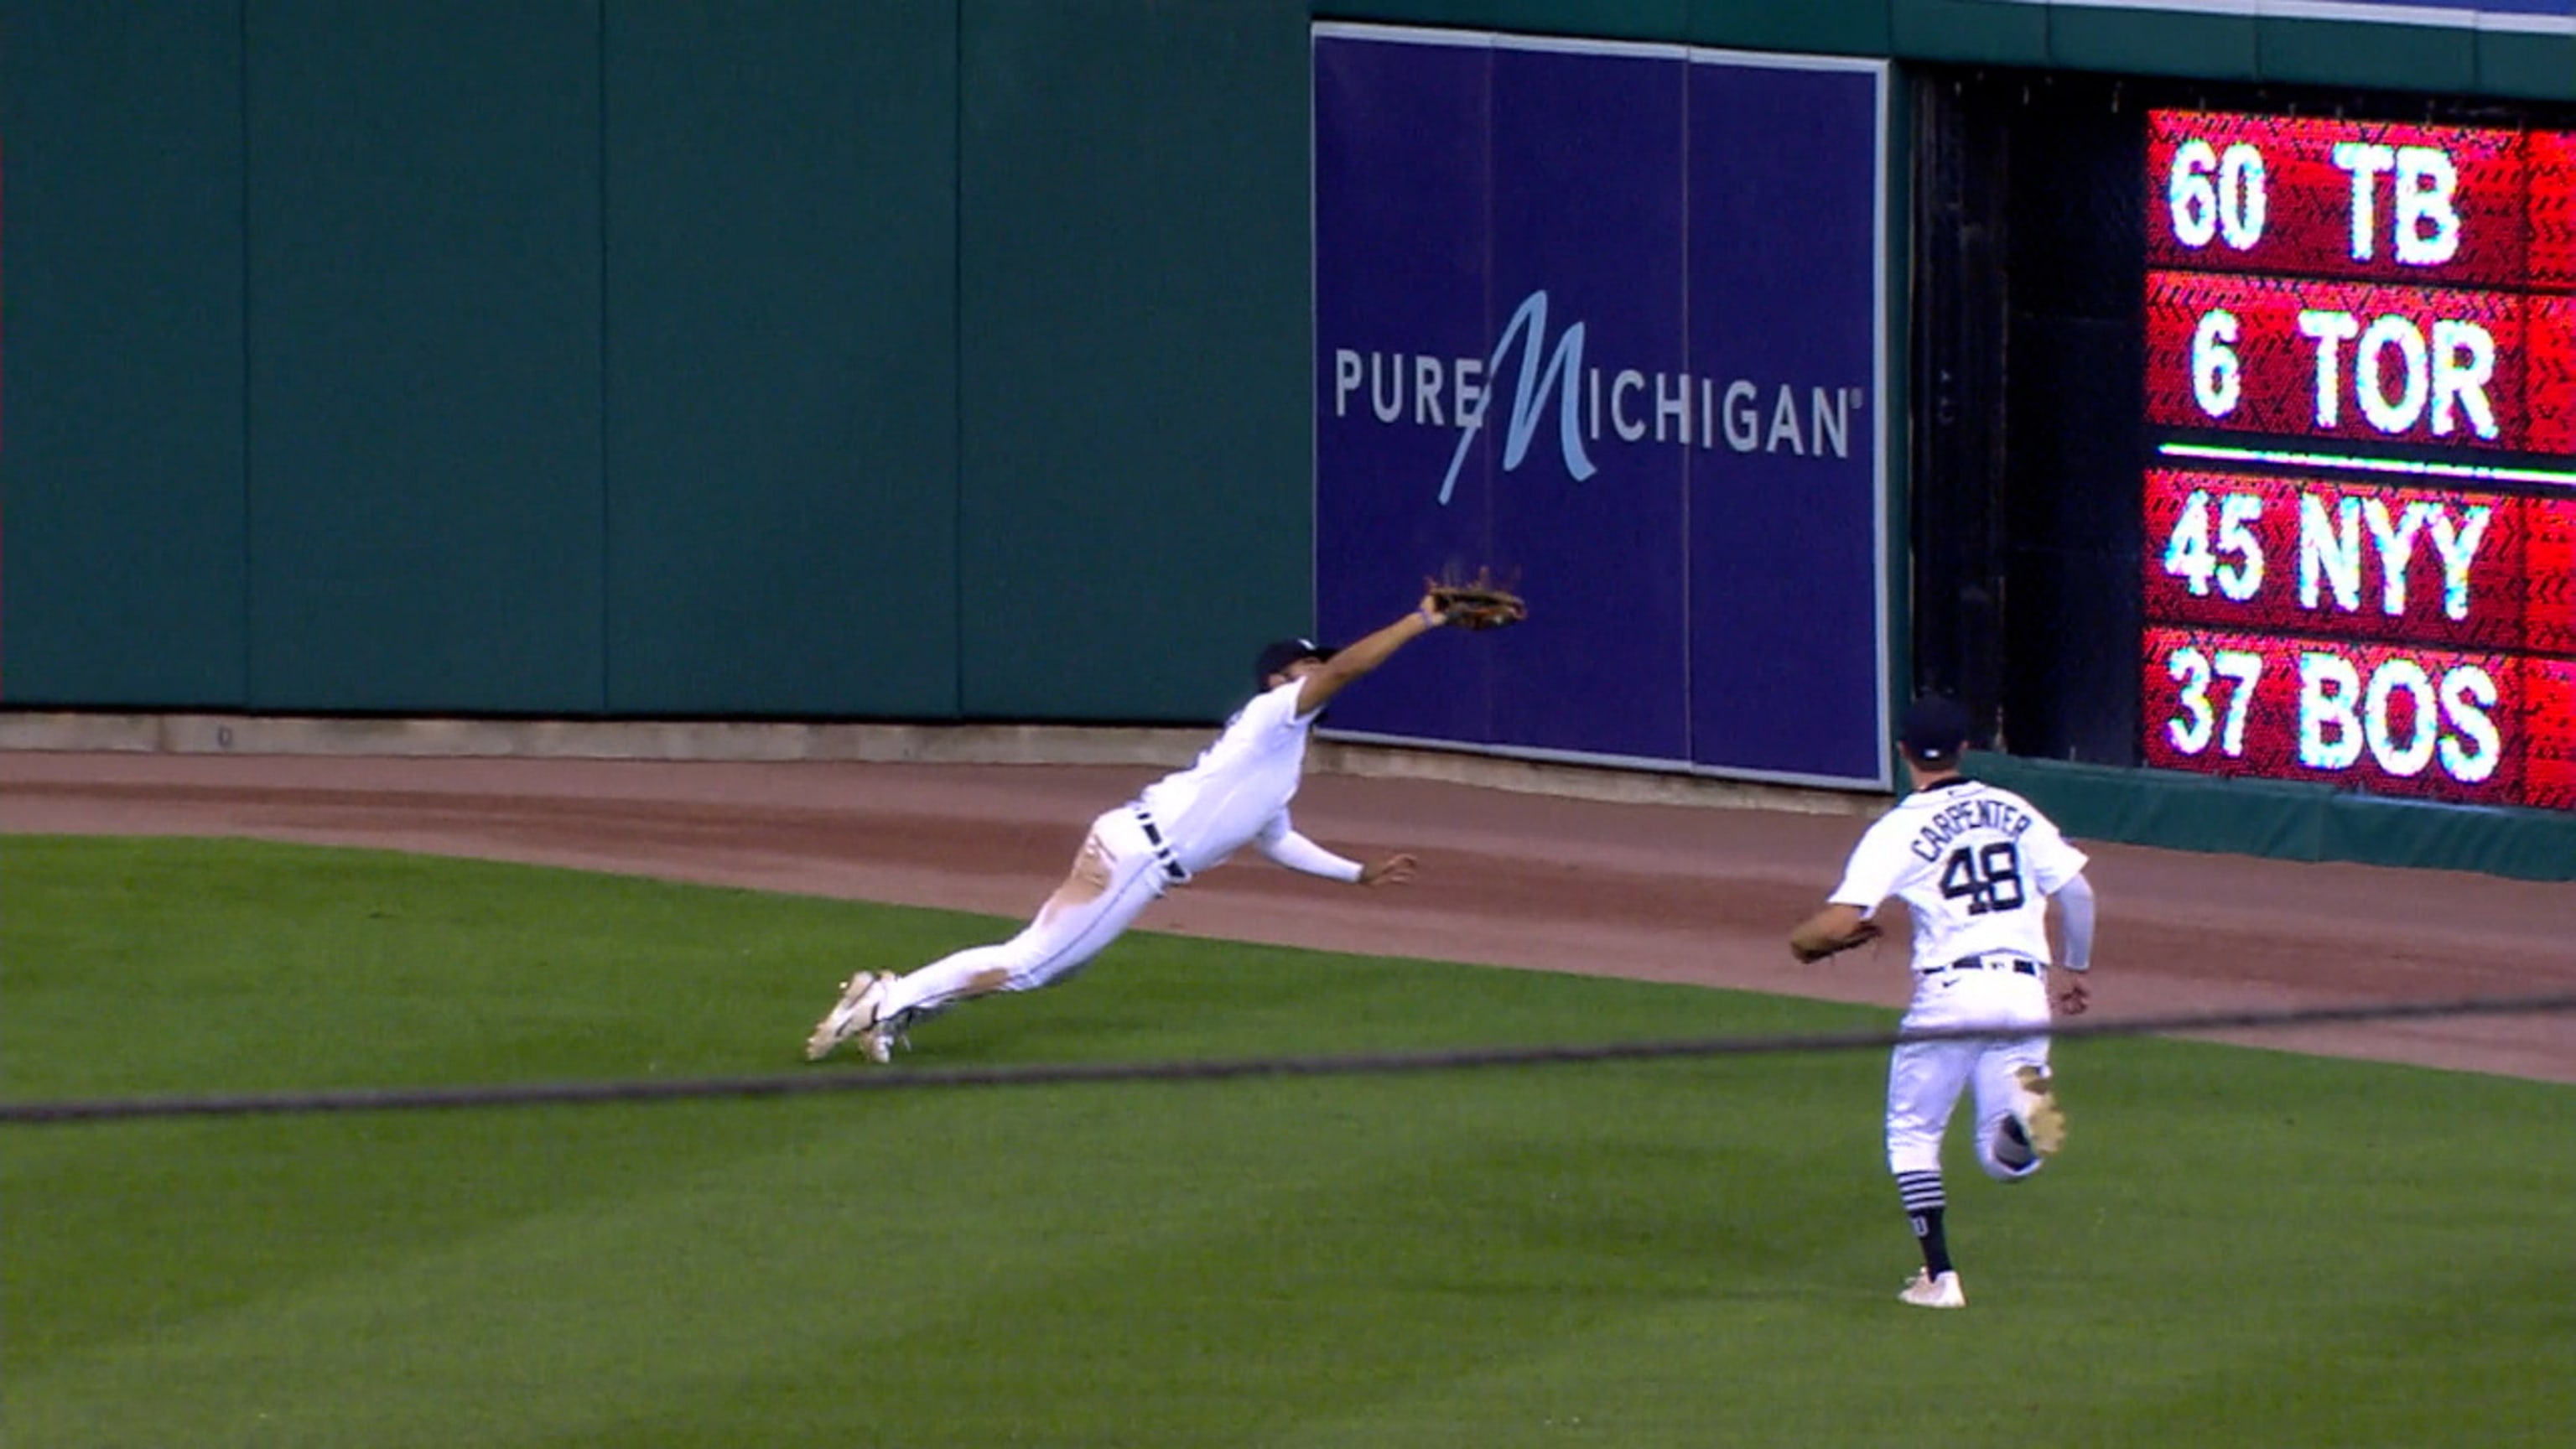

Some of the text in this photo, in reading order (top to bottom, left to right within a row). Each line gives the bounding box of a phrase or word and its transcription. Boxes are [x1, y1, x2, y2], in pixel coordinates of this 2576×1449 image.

[2169, 138, 2460, 266] 60 TB
[1336, 348, 1484, 428] PURE
[2192, 309, 2500, 439] 6 TOR
[2164, 489, 2492, 621] 45 NYY
[2167, 647, 2501, 783] 37 BOS
[1911, 800, 2032, 862] CARPENTER
[1939, 841, 2025, 915] 48
